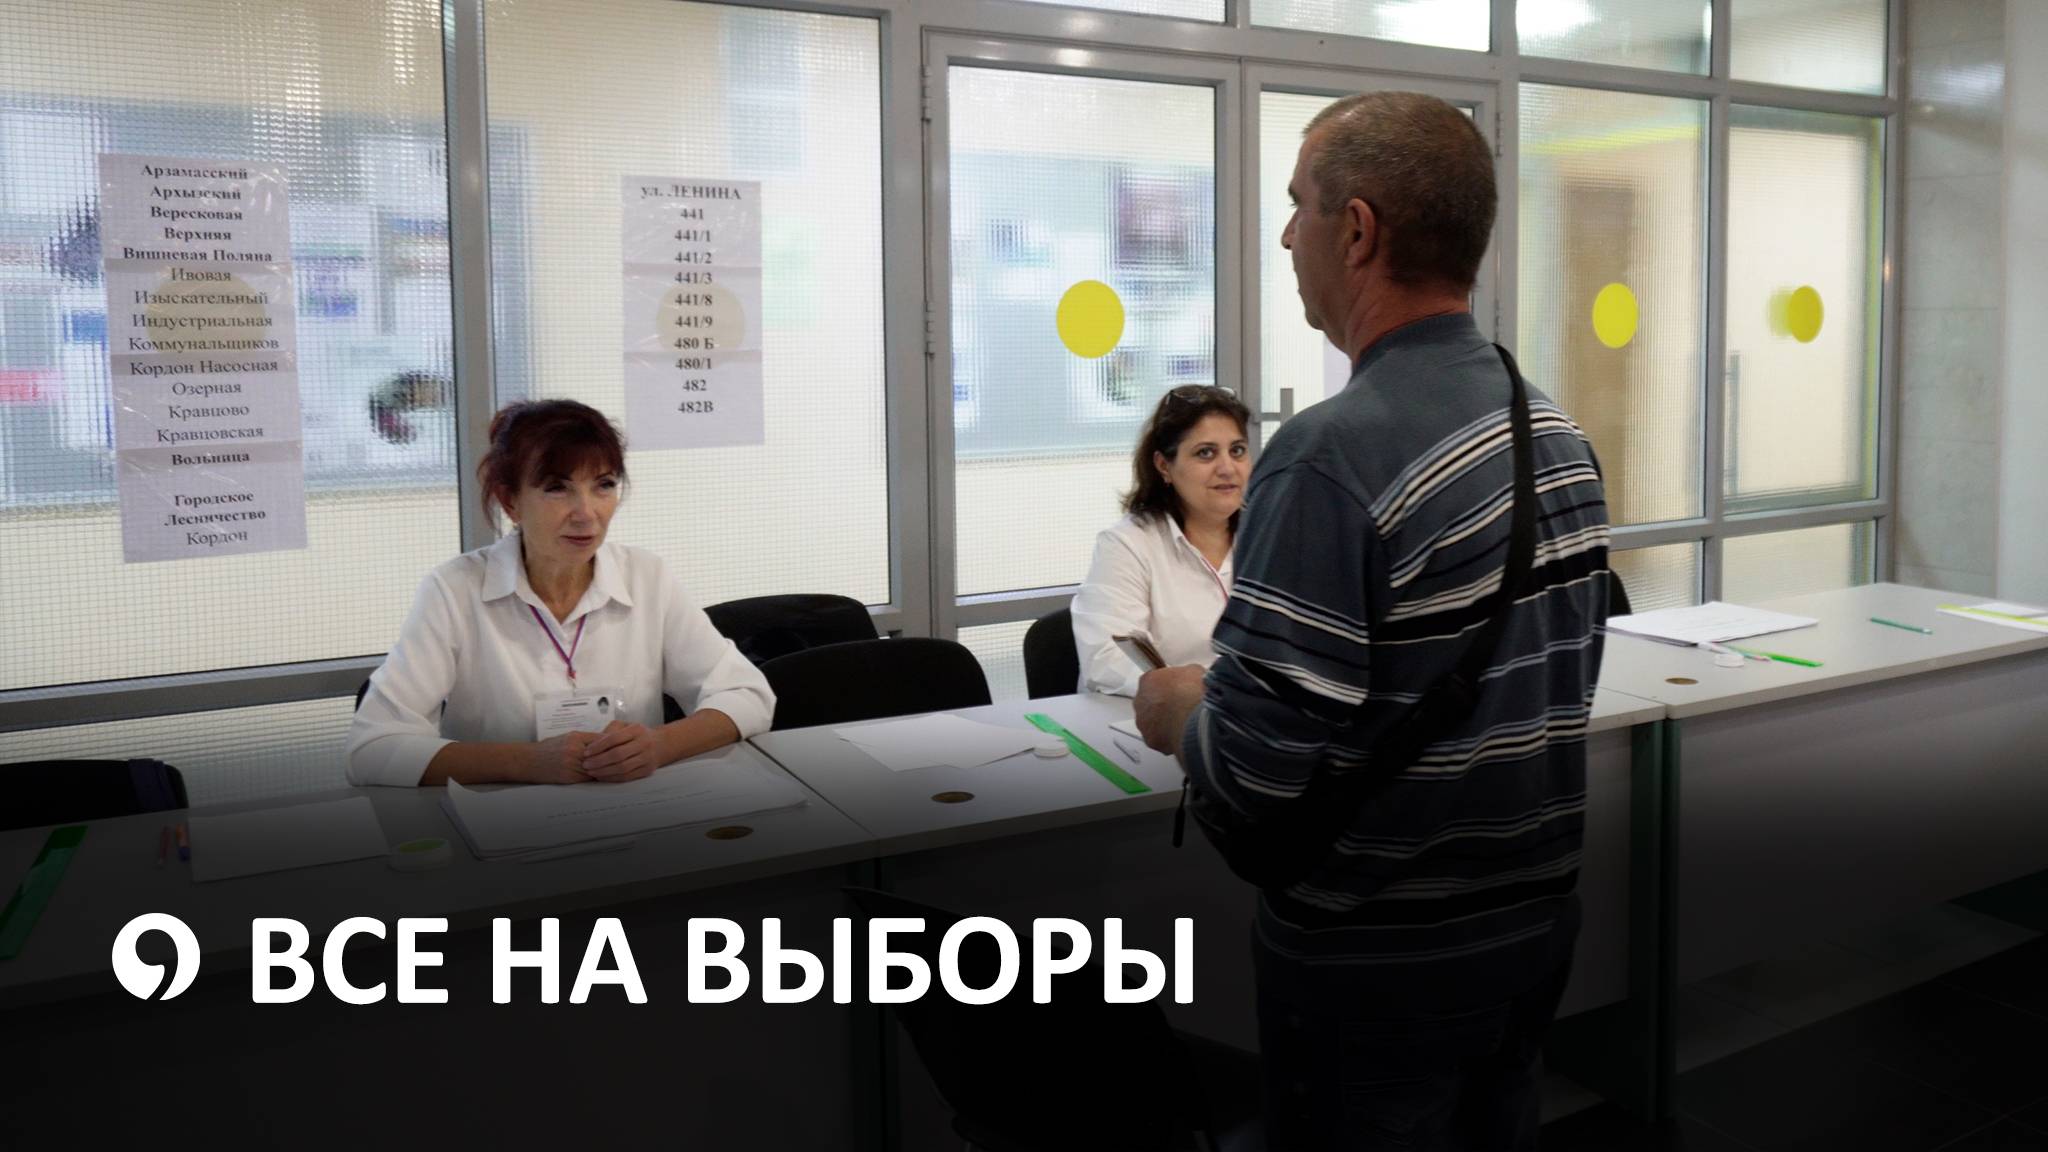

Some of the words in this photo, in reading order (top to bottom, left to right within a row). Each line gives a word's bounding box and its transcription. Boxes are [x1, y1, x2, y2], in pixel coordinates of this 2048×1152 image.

[141, 165, 248, 179] Арзамасский
[150, 186, 242, 200] Архызский
[641, 186, 664, 199] ул.
[667, 184, 742, 200] ЛЕНИНА
[150, 206, 243, 221] Вересковая
[680, 208, 704, 220] 441
[164, 227, 232, 242] Верхняя
[674, 230, 711, 242] 441/1
[123, 247, 208, 261] Вишневая
[213, 249, 273, 262] Поляна
[675, 252, 712, 264] 441/2
[171, 268, 232, 282] Ивовая
[674, 272, 713, 284] 441/3
[135, 290, 269, 304] Изыскательный
[675, 294, 713, 306] 441/8
[132, 314, 273, 330] Индустриальная
[675, 315, 713, 328] 441/9
[129, 337, 280, 353] Коммунальщиков
[674, 338, 700, 349] 480
[703, 337, 714, 349] Б
[130, 362, 194, 378] Кордон
[200, 360, 278, 373] Насосная
[675, 357, 712, 370] 480/1
[172, 382, 242, 397] Озерная
[682, 379, 707, 391] 482
[169, 405, 249, 421] Кравцово
[677, 401, 714, 413] 482В
[157, 428, 264, 444] Кравцовская
[171, 453, 250, 466] Вольница
[174, 492, 254, 508] Городское
[164, 510, 266, 526] Лесничество
[186, 531, 248, 547] Кордон
